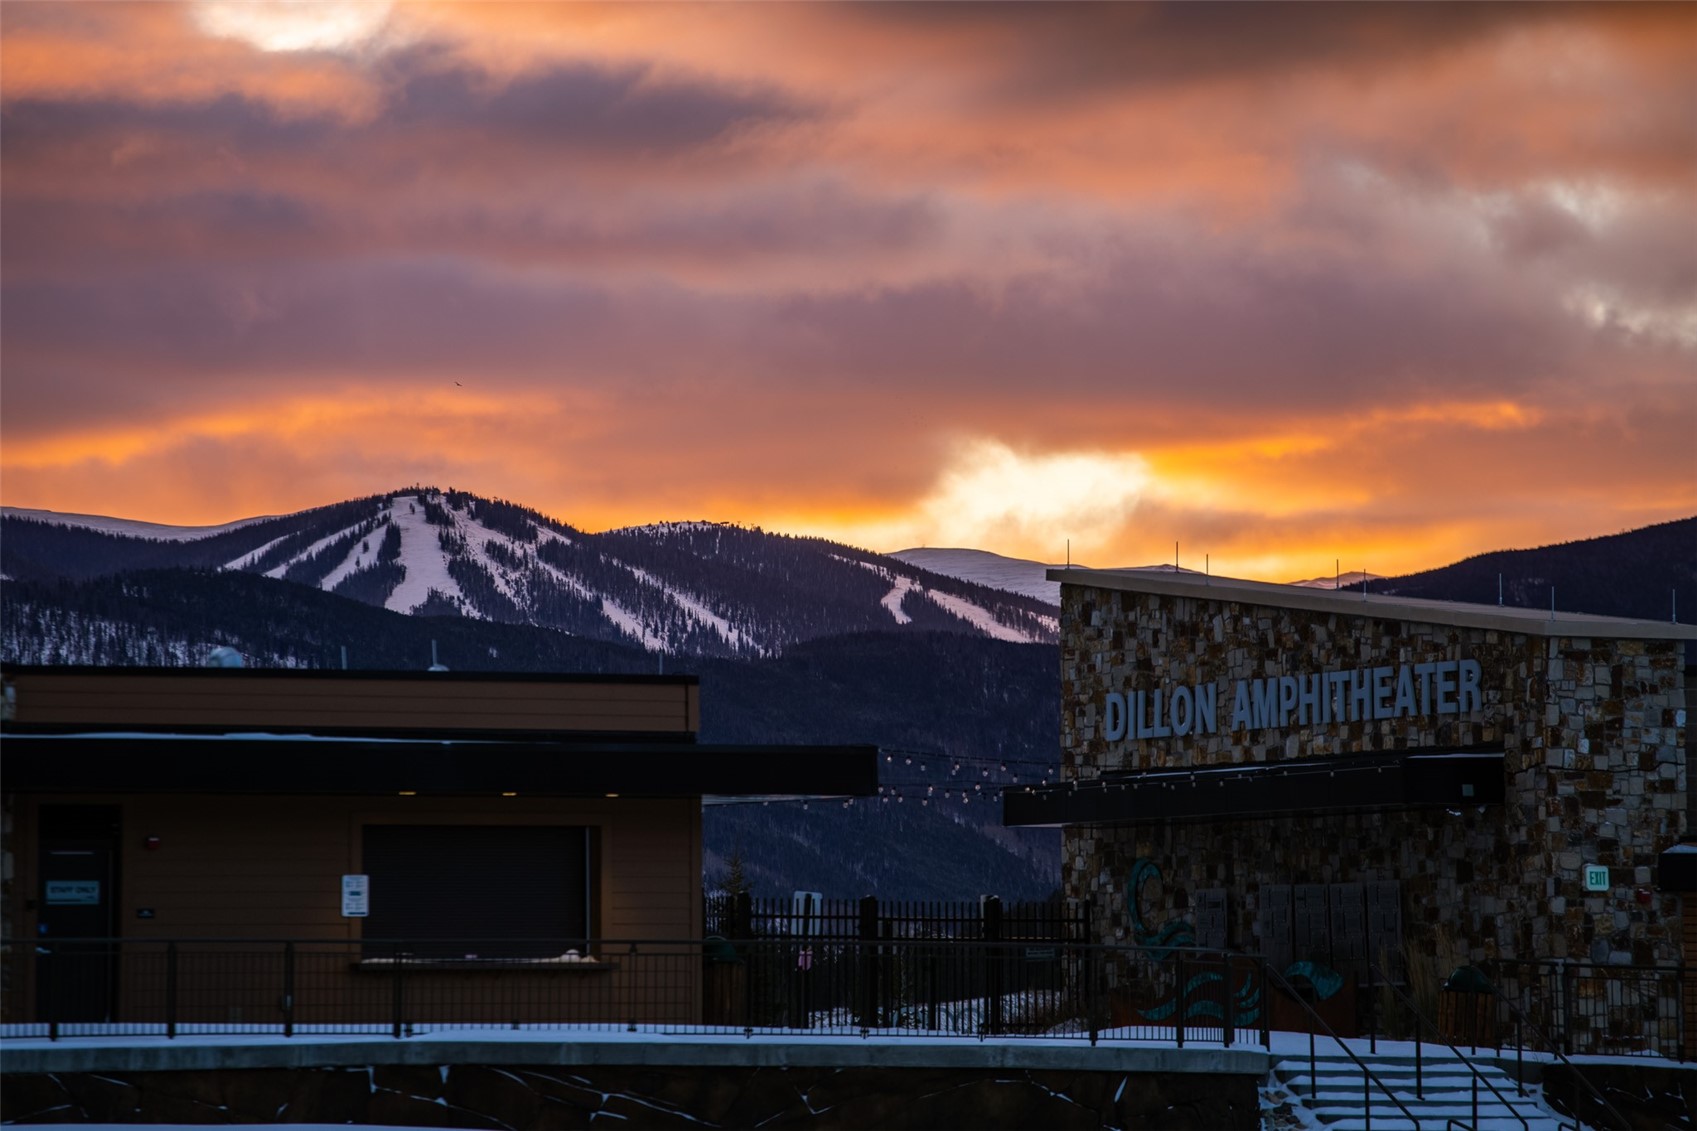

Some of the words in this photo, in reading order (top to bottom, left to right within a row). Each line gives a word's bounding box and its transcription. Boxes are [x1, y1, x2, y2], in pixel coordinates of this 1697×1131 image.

[1105, 683, 1217, 741] DILLON
[1232, 659, 1482, 731] AMPHITHEATER
[1589, 871, 1606, 885] EXIT
